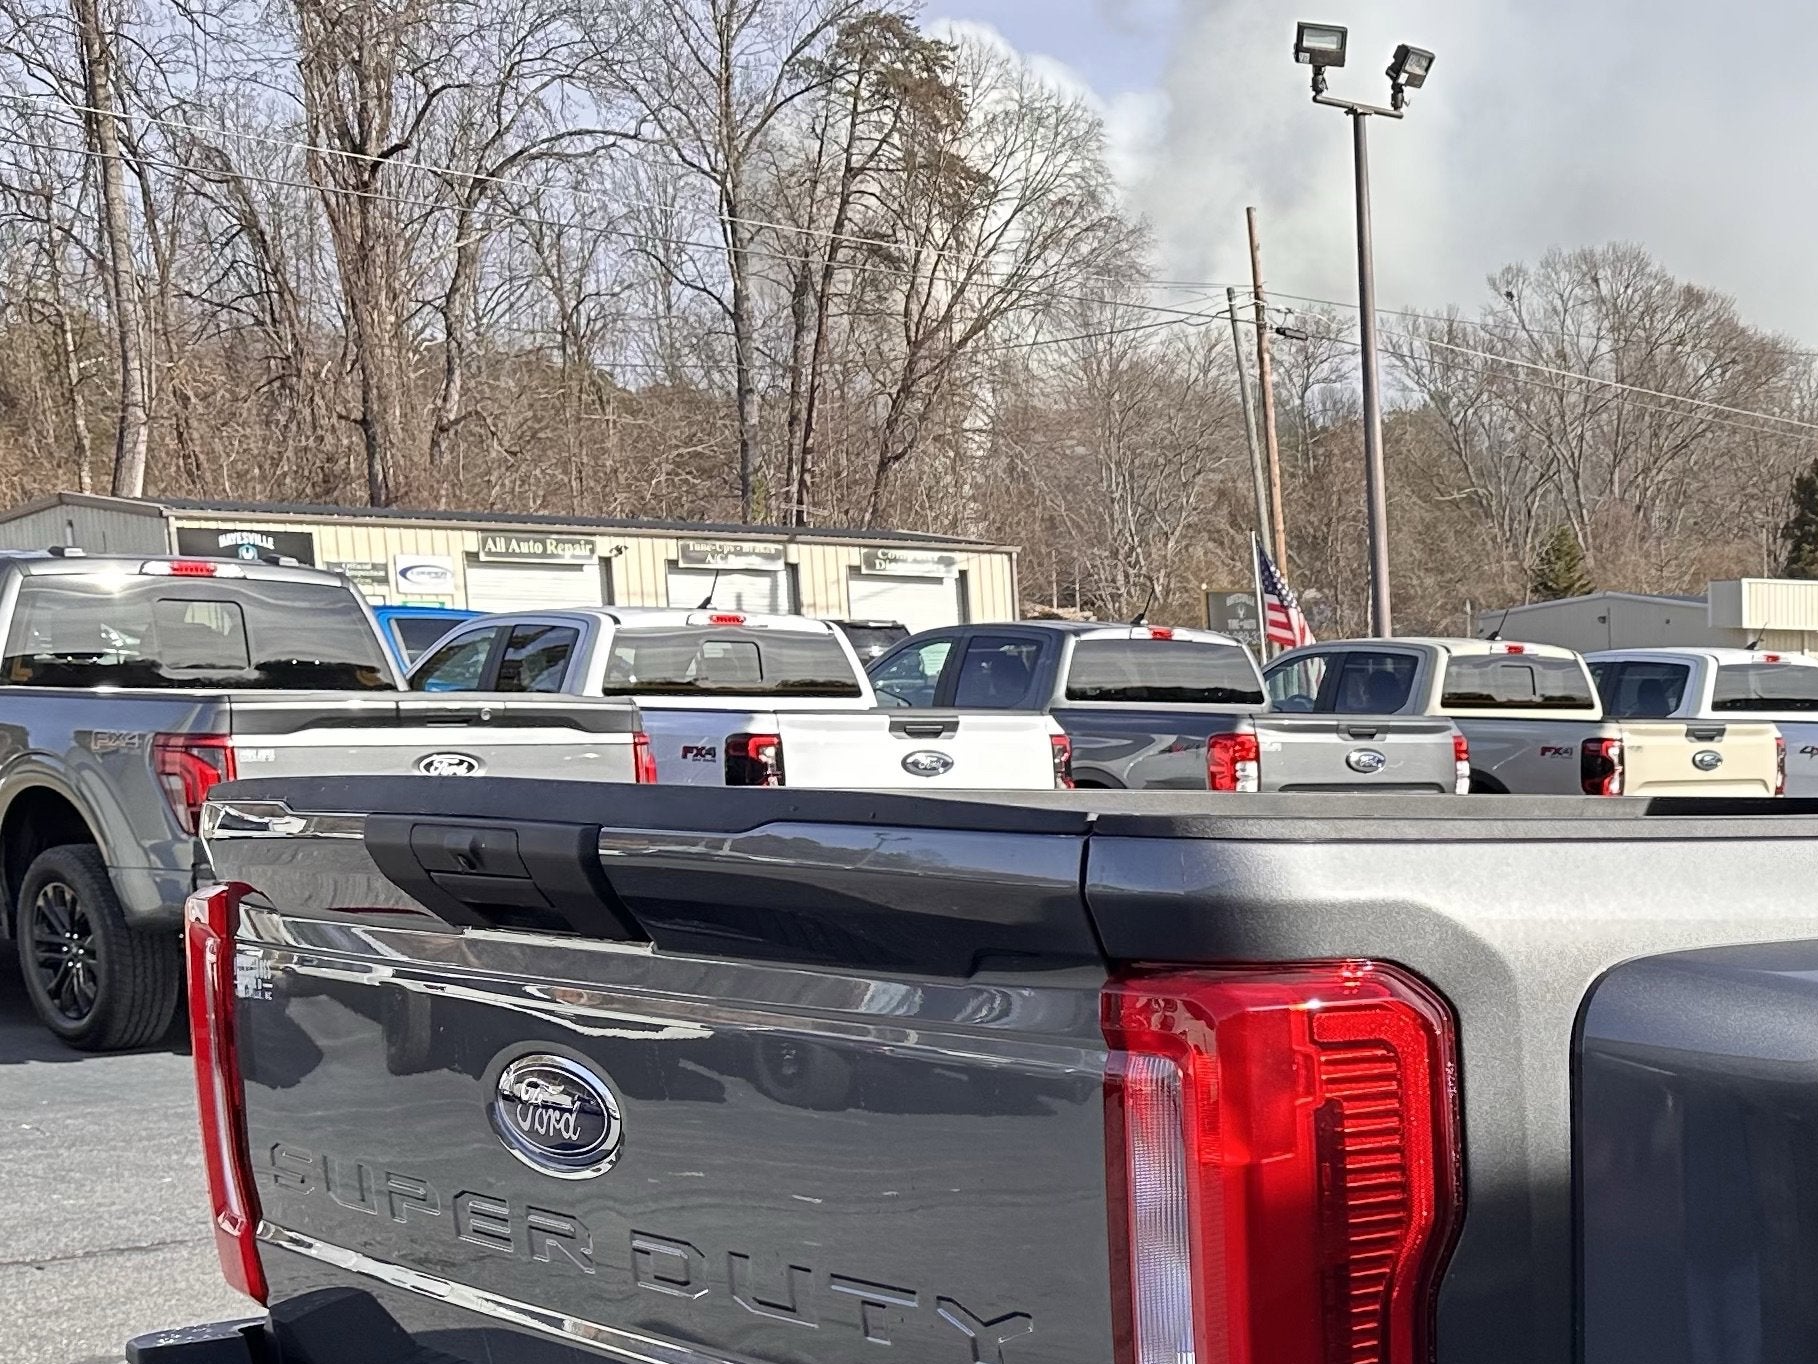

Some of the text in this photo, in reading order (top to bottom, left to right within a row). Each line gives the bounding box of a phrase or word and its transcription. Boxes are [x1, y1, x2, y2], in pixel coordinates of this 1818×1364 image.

[485, 537, 592, 559] All Auto Repair
[91, 731, 139, 750] FX4
[681, 745, 716, 759] FX4
[1540, 746, 1573, 757] FX4
[515, 1077, 581, 1141] Ford
[270, 1142, 596, 1274] SUPER
